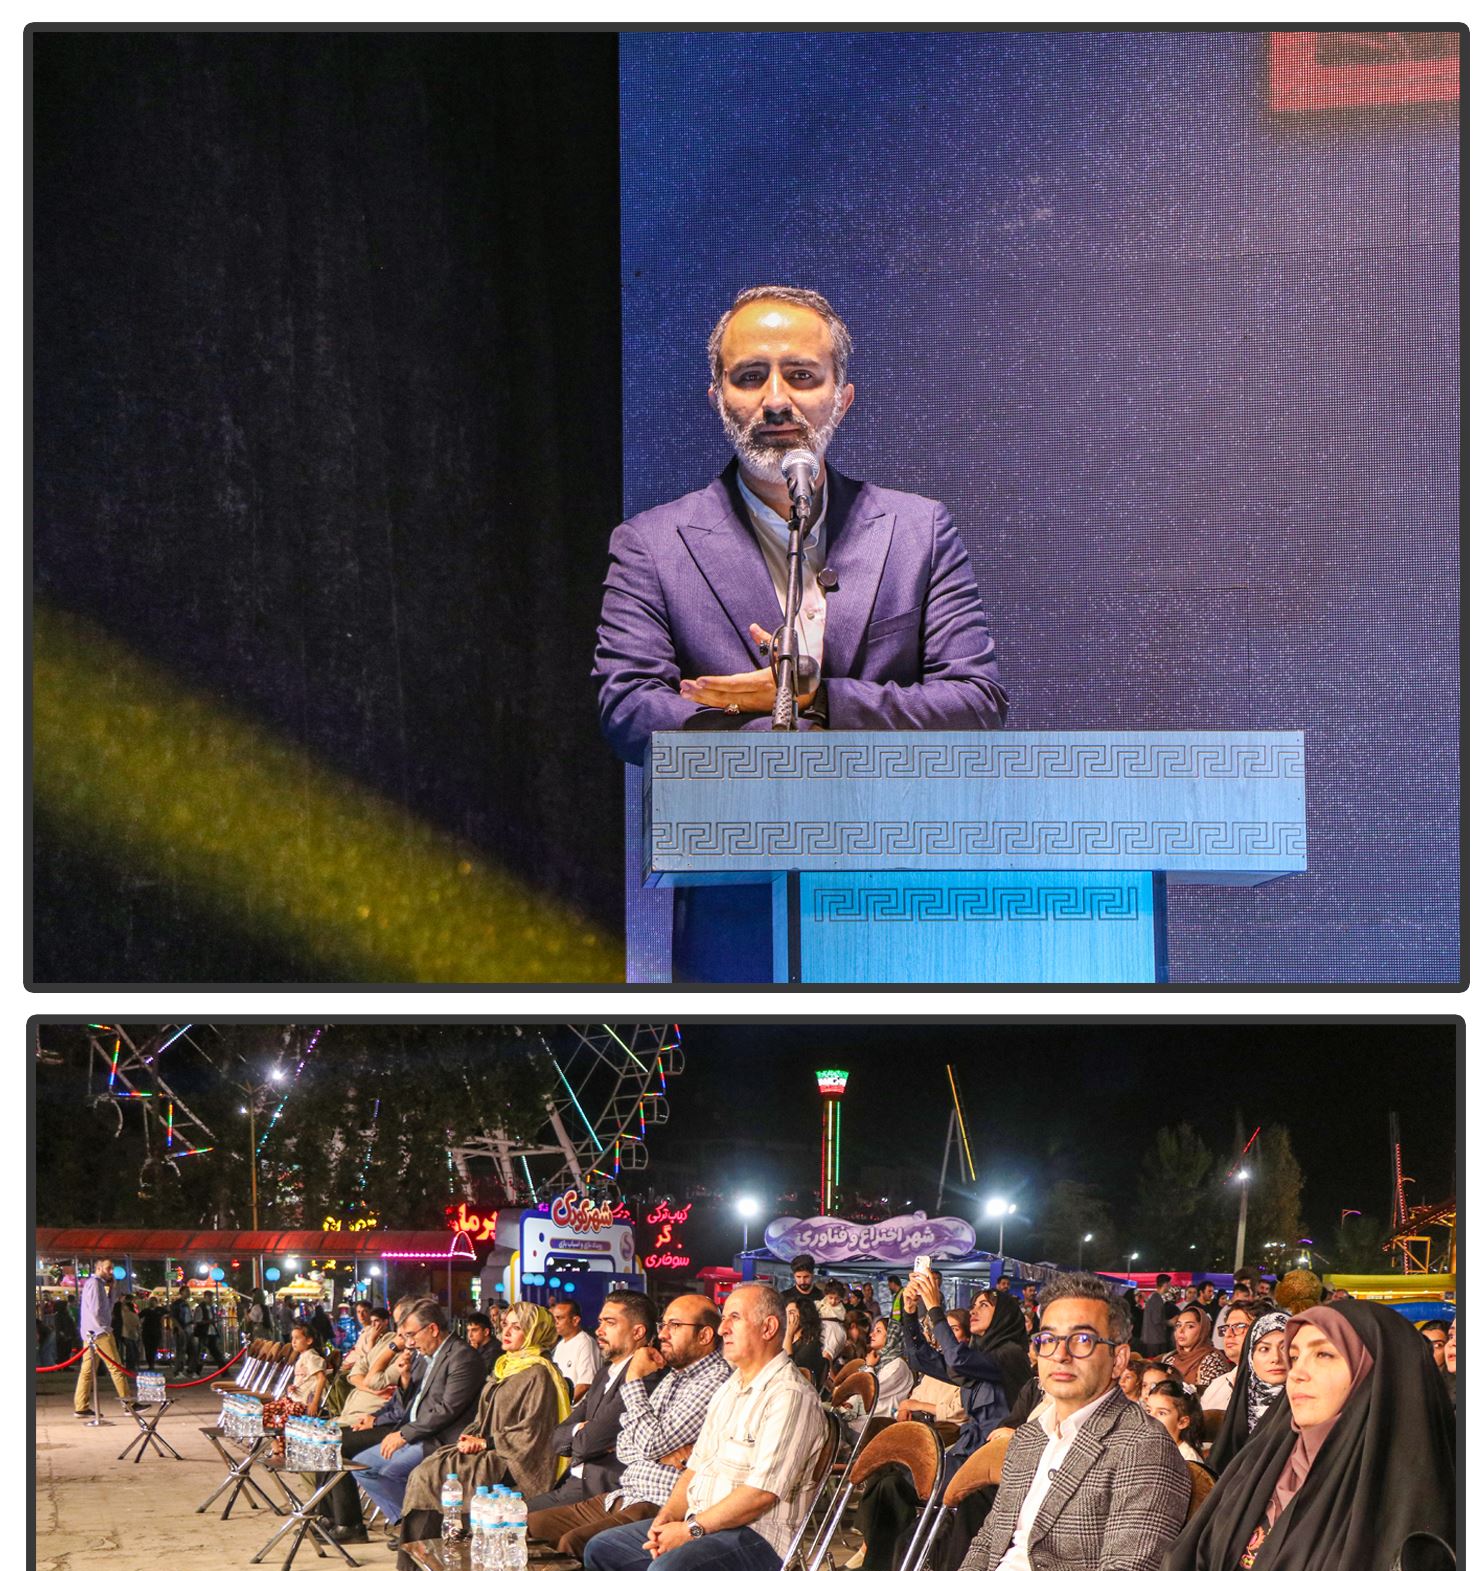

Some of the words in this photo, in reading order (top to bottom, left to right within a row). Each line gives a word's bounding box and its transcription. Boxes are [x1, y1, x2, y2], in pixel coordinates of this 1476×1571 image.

[646, 1200, 669, 1223] ترکی
[668, 1203, 693, 1223] کباب
[794, 1227, 849, 1249] فناوری
[849, 1233, 858, 1249] و
[858, 1226, 902, 1250] اختراع
[644, 1251, 691, 1269] سوخاری
